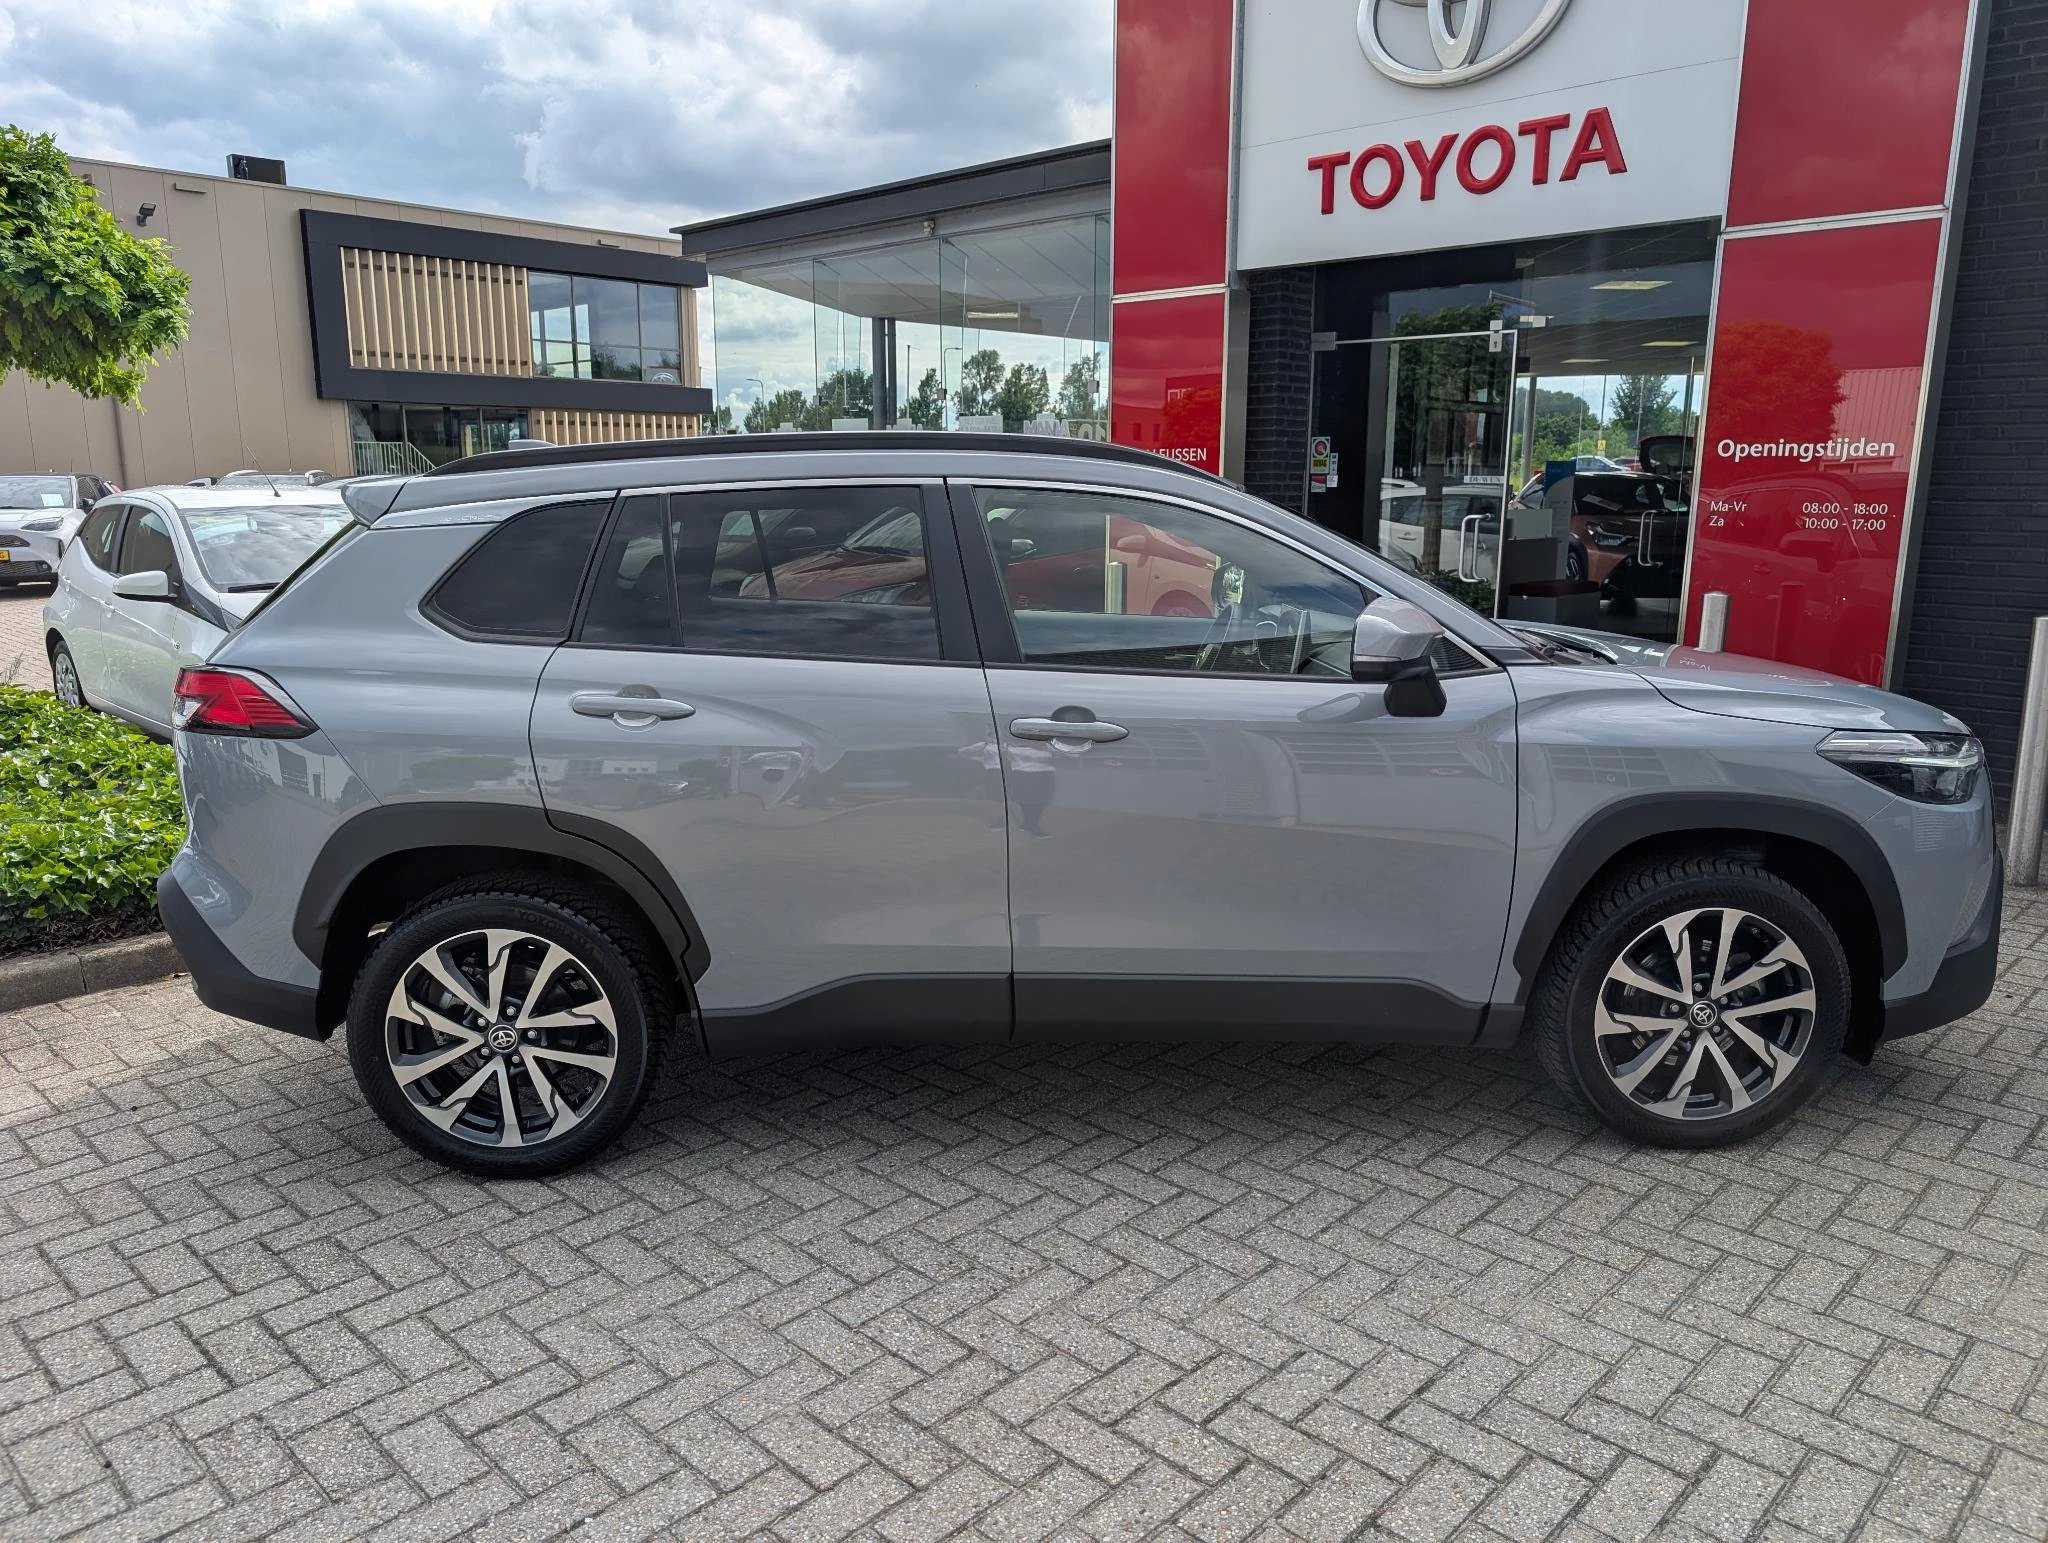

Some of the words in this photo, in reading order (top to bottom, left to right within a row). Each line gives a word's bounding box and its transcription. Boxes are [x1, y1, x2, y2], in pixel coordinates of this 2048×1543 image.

[1308, 107, 1627, 215] TOYOTA
[1717, 438, 1895, 462] Openingstijden
[1710, 501, 1747, 512] Ma-Vr
[1802, 502, 1840, 514] 08:00
[1853, 503, 1888, 515] 18:00
[1709, 516, 1724, 527] Za
[1805, 518, 1838, 529] 10:00
[1852, 519, 1886, 530] 17:00
